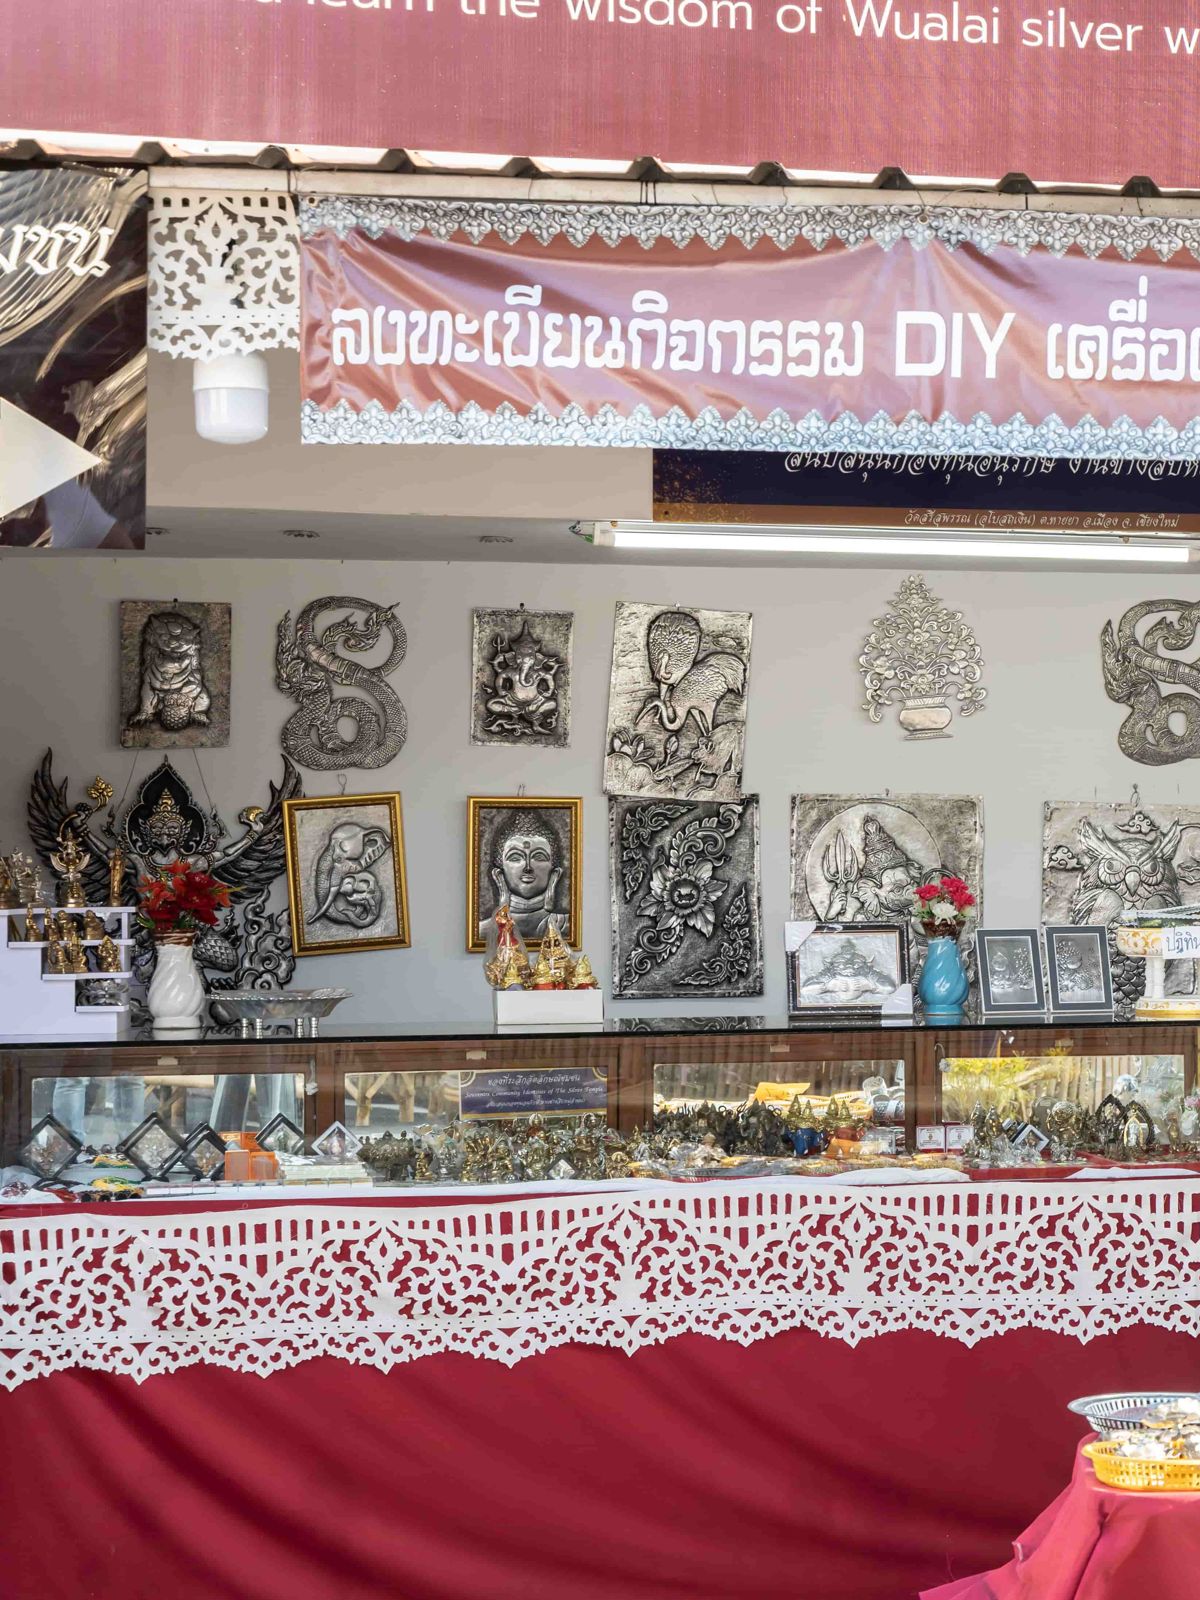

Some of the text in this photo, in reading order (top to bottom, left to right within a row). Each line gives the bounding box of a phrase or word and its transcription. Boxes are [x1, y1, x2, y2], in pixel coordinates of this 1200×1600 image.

[567, 0, 753, 30] wisdom
[776, 0, 823, 34] of
[846, 0, 1000, 44] Wualai
[1021, 7, 1144, 52] silver
[331, 284, 864, 377] ลงทะเบียนกิจกรรม
[894, 310, 1015, 380] DIY
